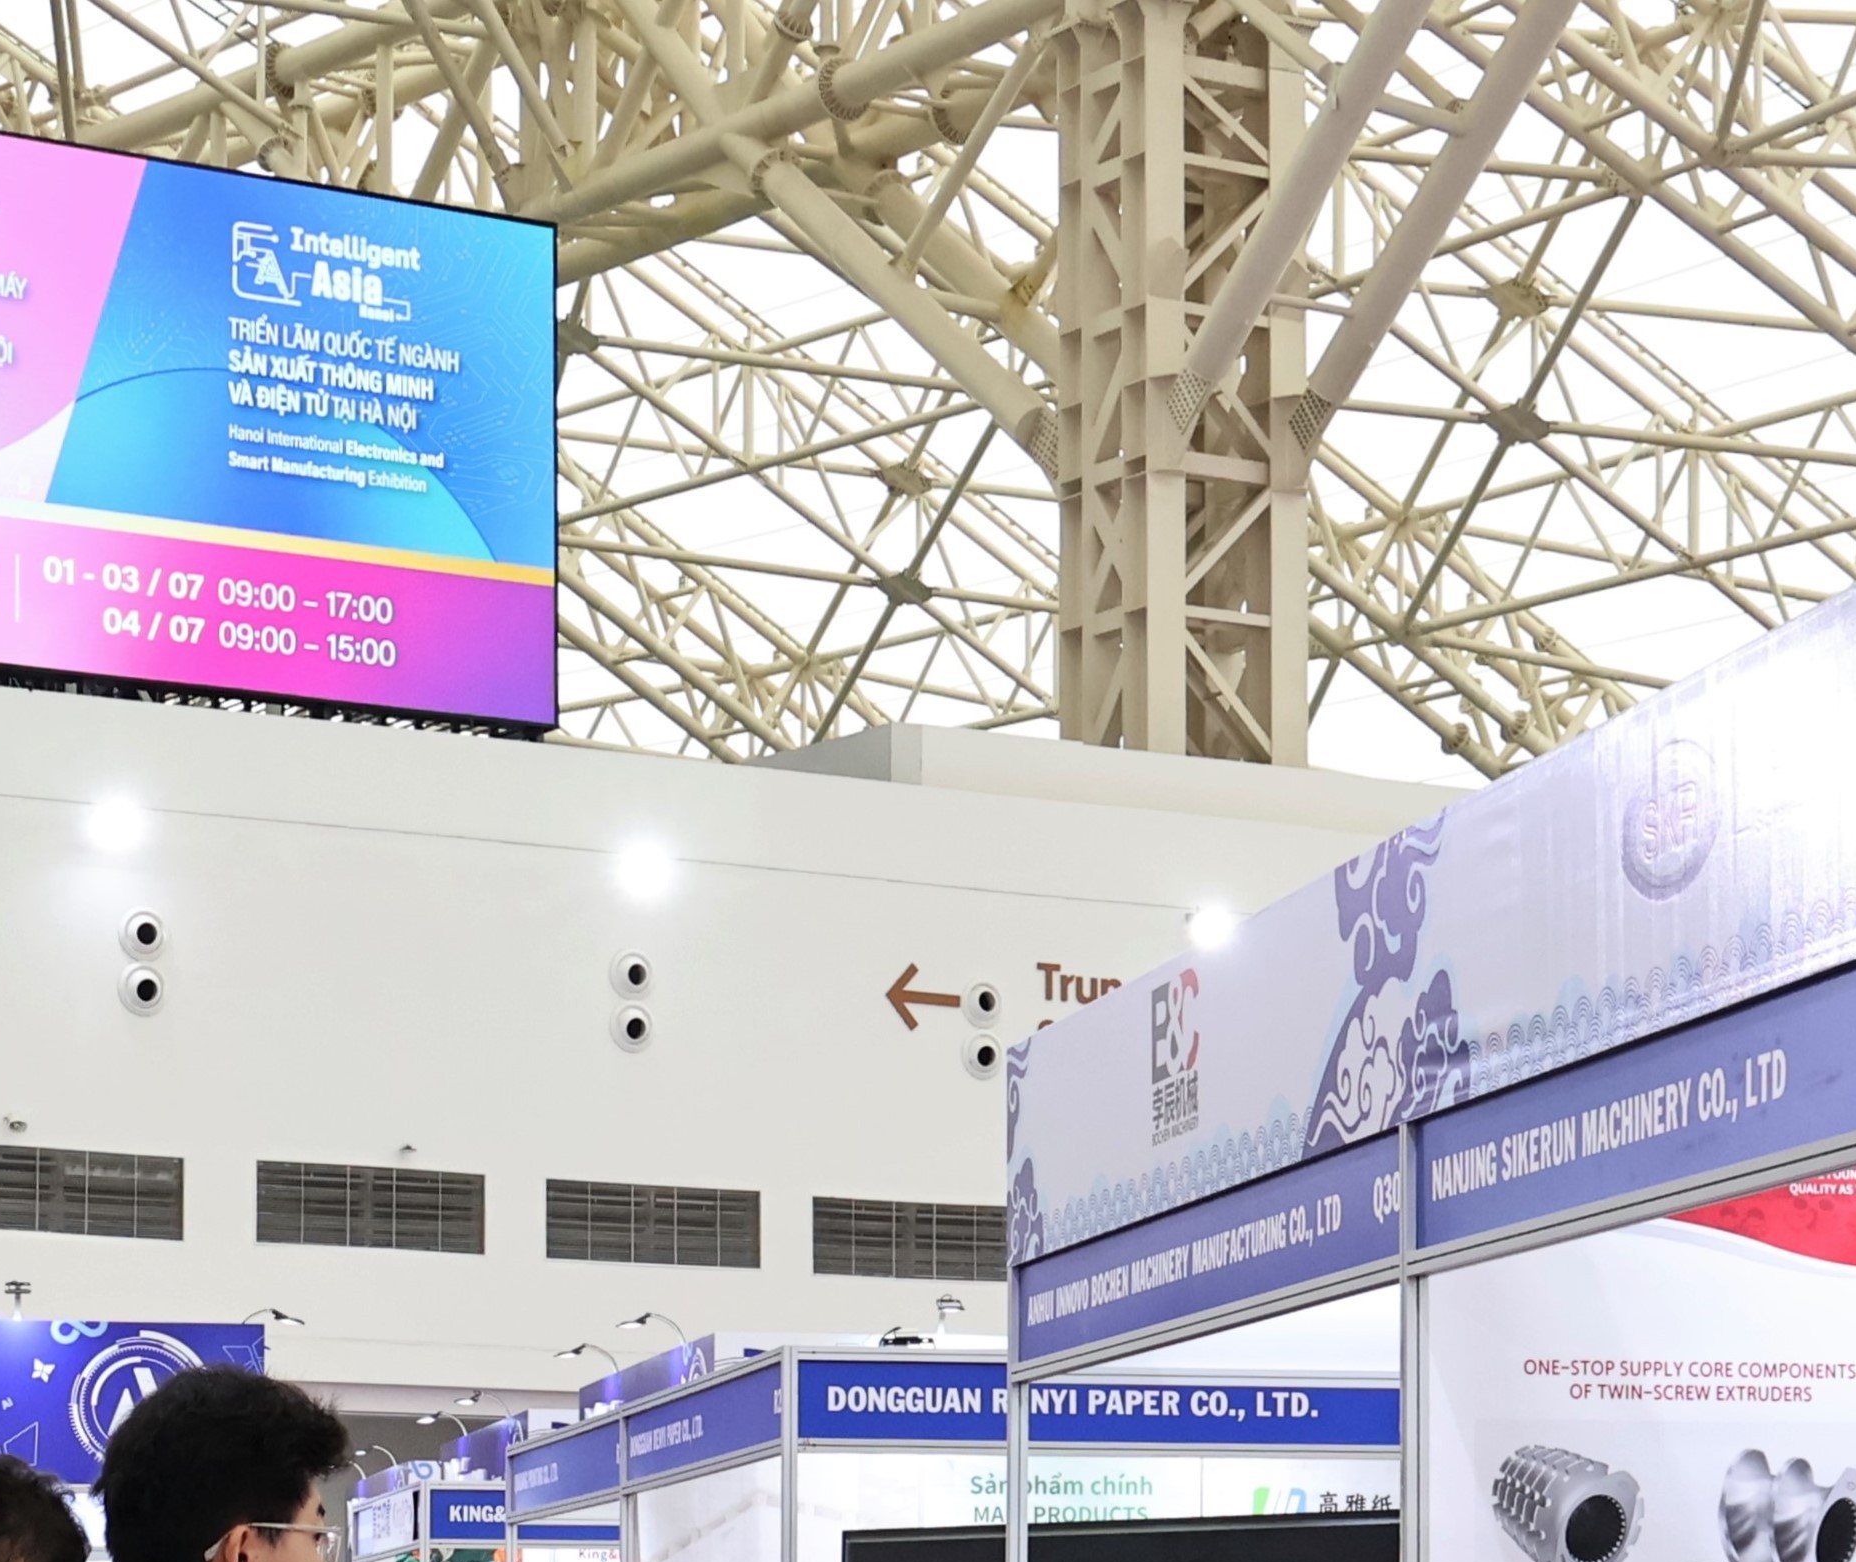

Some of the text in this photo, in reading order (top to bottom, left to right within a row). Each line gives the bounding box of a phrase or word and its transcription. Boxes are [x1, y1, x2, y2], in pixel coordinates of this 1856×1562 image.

[290, 226, 420, 270] Intelligent
[311, 260, 383, 306] Asia
[228, 314, 460, 373] TRIỂN LÃM QUỐC TẾ NGÀNH
[229, 347, 433, 401] SẢN XUẤT THÔNG MINH
[43, 556, 74, 586] 01
[102, 563, 139, 593] 03
[169, 572, 205, 601] 07
[218, 577, 296, 612] 09:00
[326, 591, 393, 625] 17:00
[1373, 1171, 1400, 1224] Q30
[1027, 1194, 1341, 1326] ANHUI INNOVO BOCHEN MACHINERY MANUFACTURING CO., LTD
[1523, 1359, 1856, 1379] ONE-STOP SUPPLY CORE COMPONENTS
[828, 1384, 1319, 1422] DONGGUAN RNYI PAPER CO., LTD.
[1569, 1384, 1812, 1402] OF TWIN-SCREW EXTRUDERS
[1092, 1476, 1152, 1496] chính
